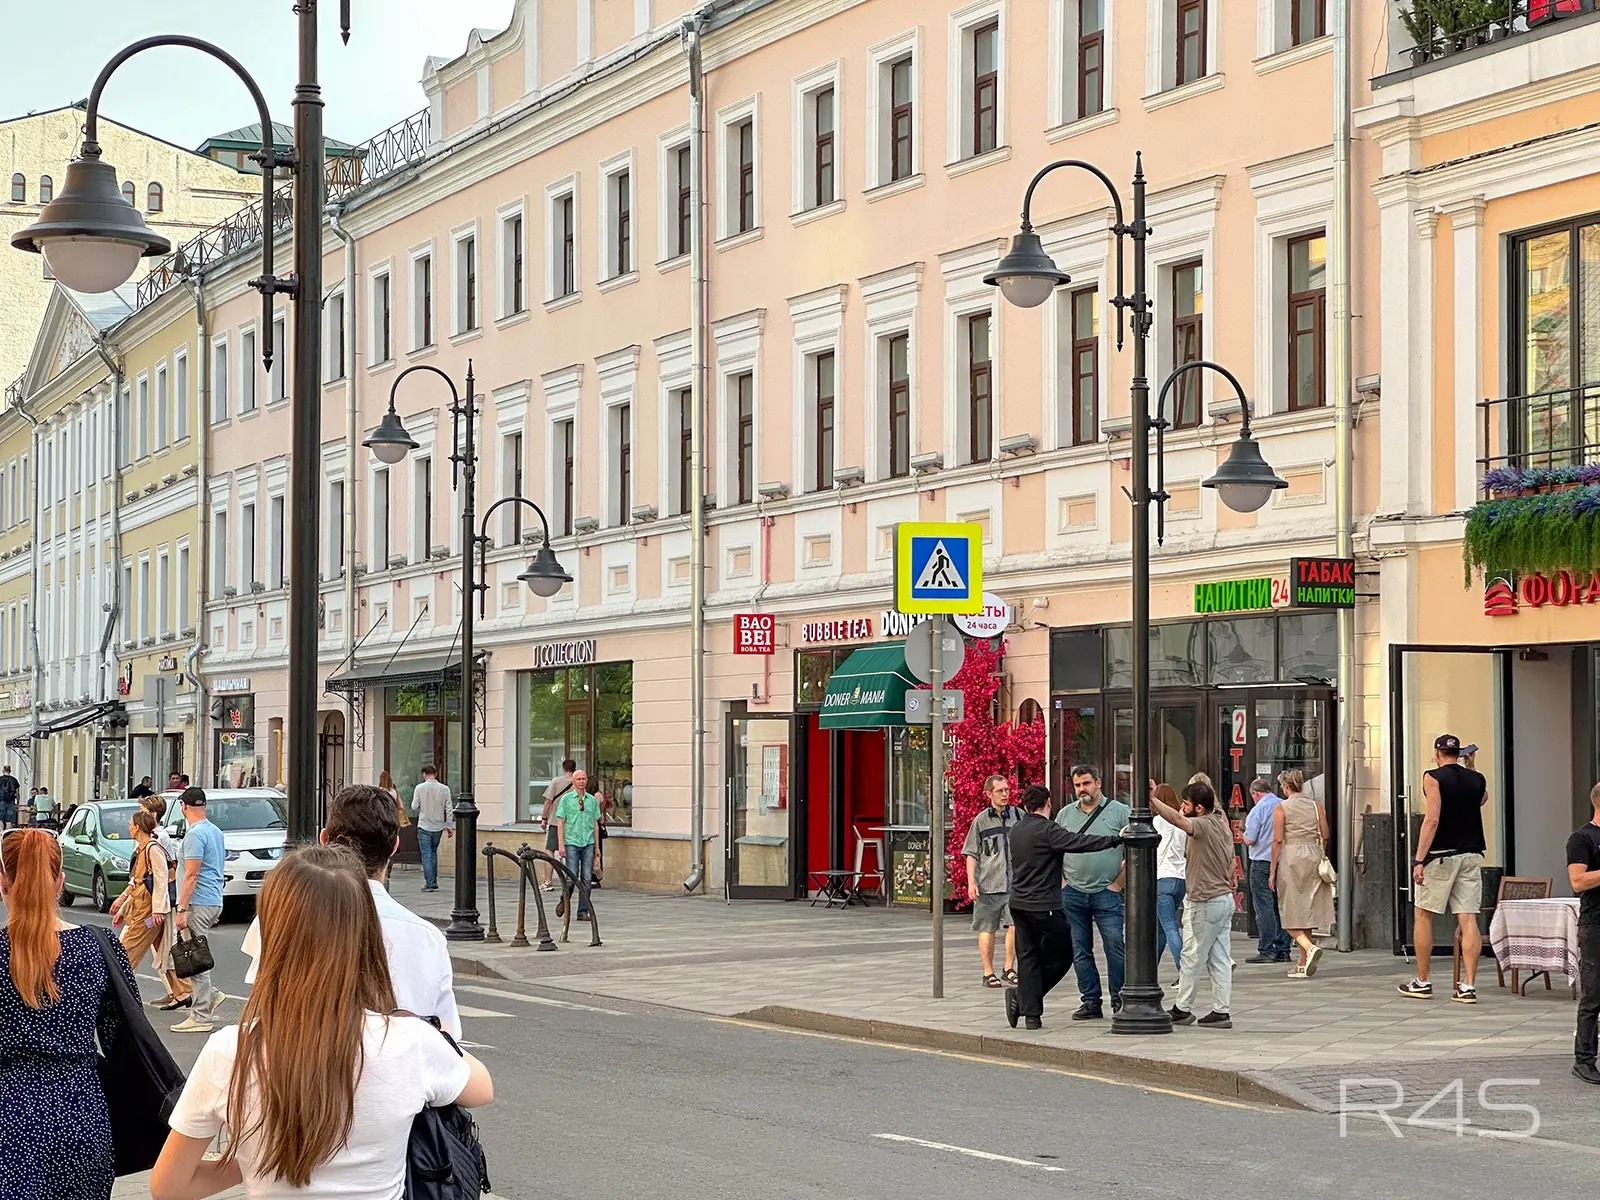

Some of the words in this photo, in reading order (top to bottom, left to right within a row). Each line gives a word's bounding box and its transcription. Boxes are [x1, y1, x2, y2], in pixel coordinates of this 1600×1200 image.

[1298, 560, 1354, 584] ТАБАК
[1194, 577, 1272, 612] НАПИТКИ
[1272, 579, 1289, 603] 24
[1297, 587, 1355, 604] НАПИТКИ
[740, 616, 772, 630] BAO
[802, 621, 844, 642] BUBBLE
[846, 618, 870, 638] TEA
[967, 621, 977, 629] 24
[978, 622, 997, 630] часа
[740, 630, 772, 646] BEI
[540, 639, 595, 665] COLLECTION
[824, 692, 851, 708] DONER
[859, 690, 885, 705] MANIA
[1230, 748, 1244, 912] ТАБАК
